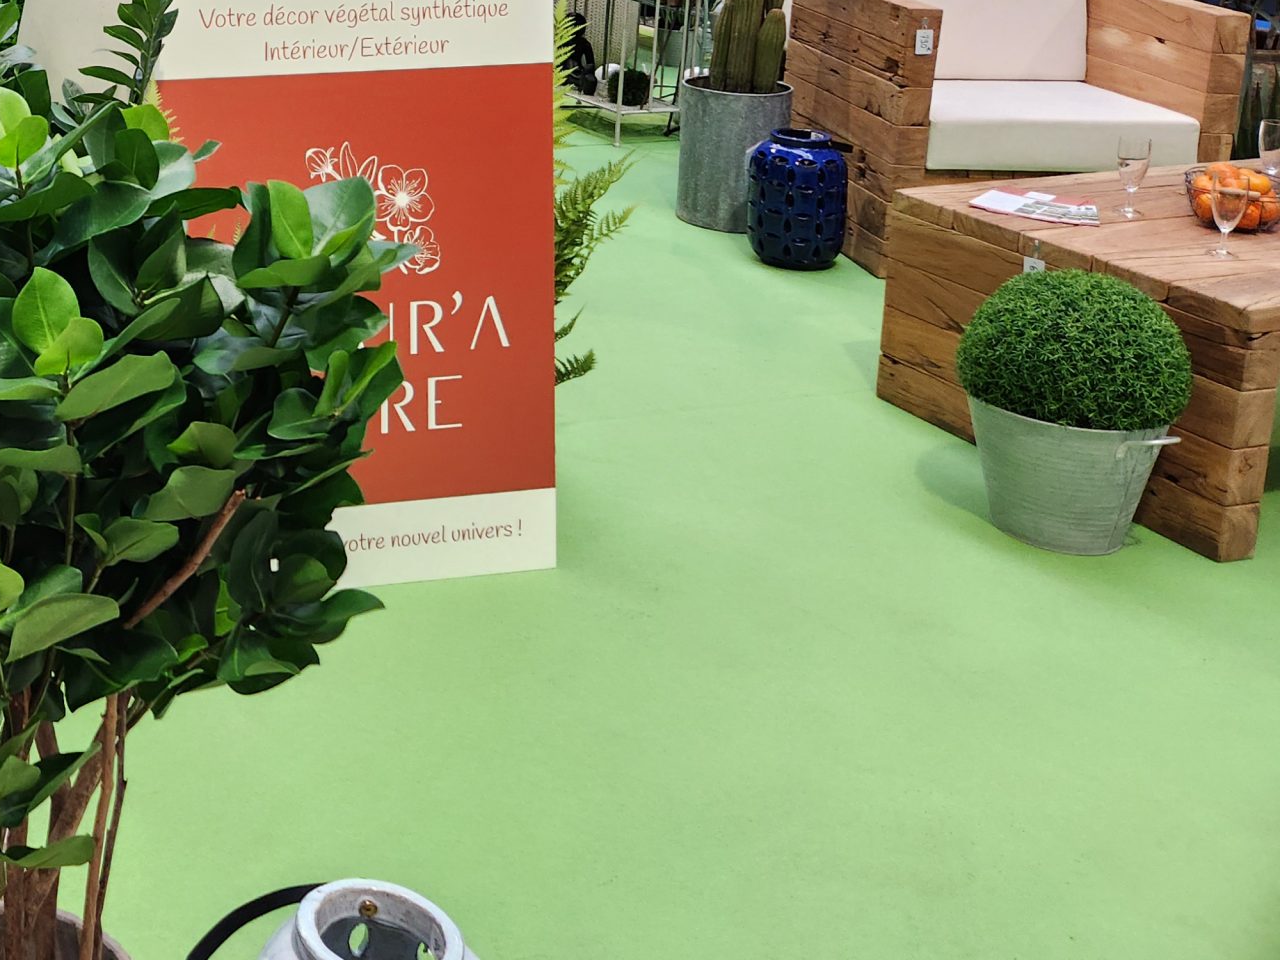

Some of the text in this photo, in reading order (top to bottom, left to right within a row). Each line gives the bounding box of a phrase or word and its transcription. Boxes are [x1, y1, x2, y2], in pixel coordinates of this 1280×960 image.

[198, 7, 257, 29] Votre
[263, 4, 319, 26] décor
[324, 1, 395, 29] végétal
[264, 34, 450, 62] Intérieur/Extérieur
[391, 525, 447, 548] nouvel
[451, 522, 512, 542] univers
